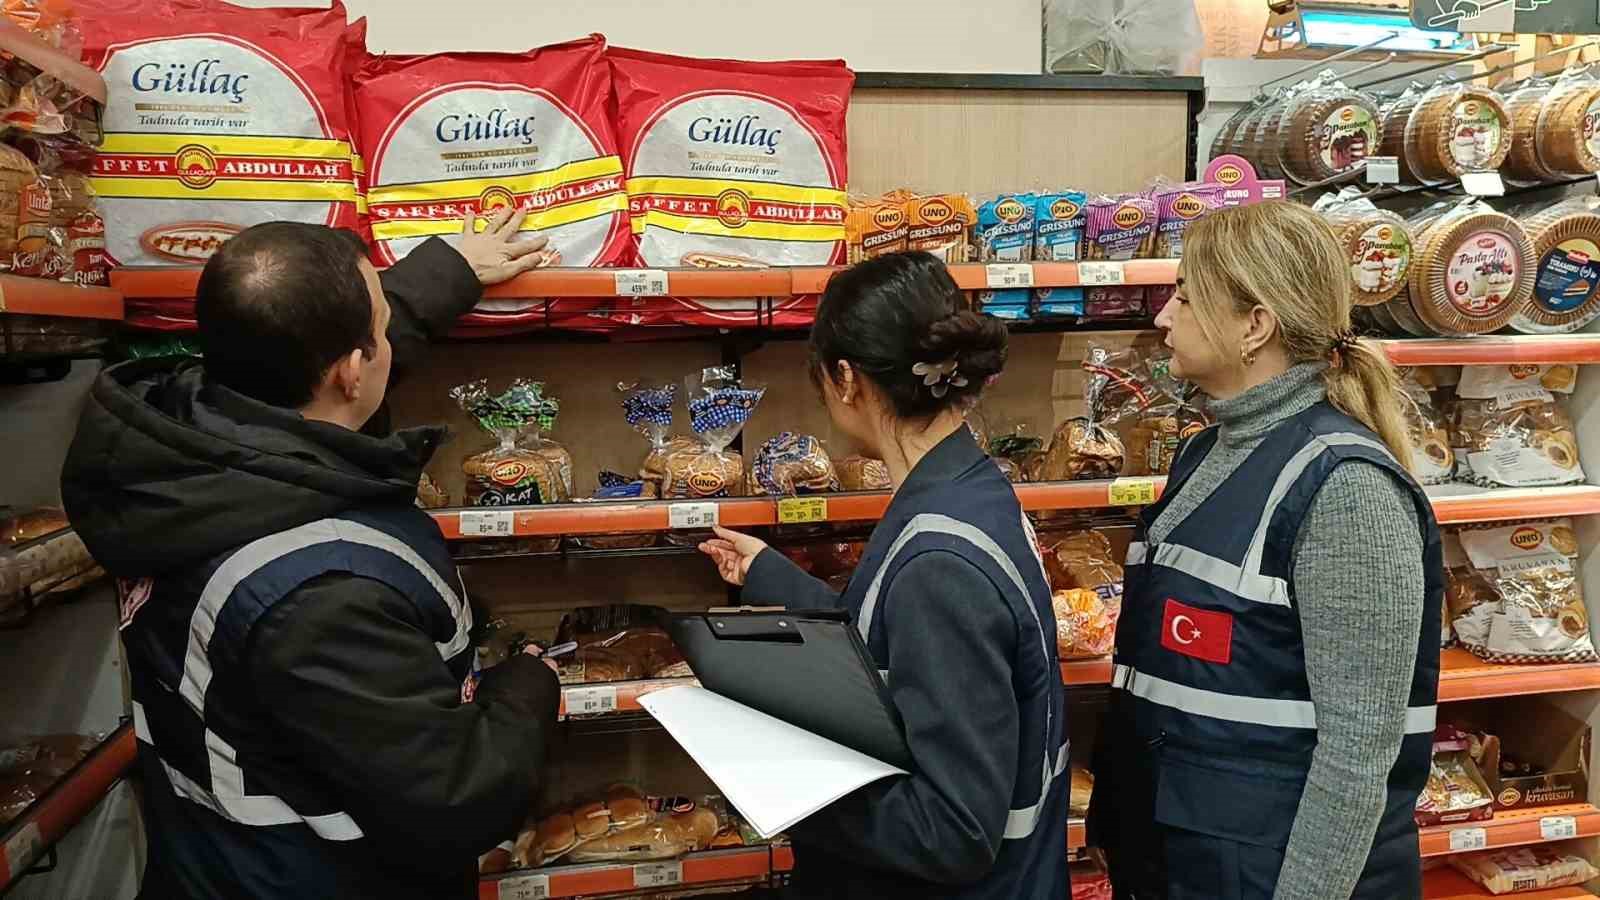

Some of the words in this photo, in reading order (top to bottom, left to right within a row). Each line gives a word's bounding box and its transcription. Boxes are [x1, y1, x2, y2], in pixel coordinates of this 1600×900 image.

[132, 59, 249, 104] Güllaç
[435, 108, 535, 144] Güllaç
[688, 115, 781, 154] Güllaç
[93, 159, 169, 173] FFET
[223, 161, 341, 177] ABDULLAH
[376, 204, 475, 218] SAFFET
[522, 178, 620, 210] ABDULLAH
[630, 198, 713, 213] SAFFET
[754, 205, 843, 222] ABDULLAH
[922, 207, 947, 218] UNO
[999, 205, 1020, 216] UNO
[1176, 201, 1200, 212] UNO
[878, 211, 900, 223] UNO
[1039, 216, 1086, 234] GRISSUNO
[1117, 212, 1138, 222] UNO
[909, 223, 962, 239] GRISSUNO
[984, 219, 1032, 239] GRISSUNO
[1159, 220, 1190, 232] GRISS
[1098, 225, 1151, 244] GRISSUNO
[1459, 252, 1487, 266] Pasta
[694, 479, 717, 487] UNO
[505, 487, 533, 505] KAT
[1515, 533, 1538, 544] UNO
[1525, 789, 1575, 803] kruvasan
